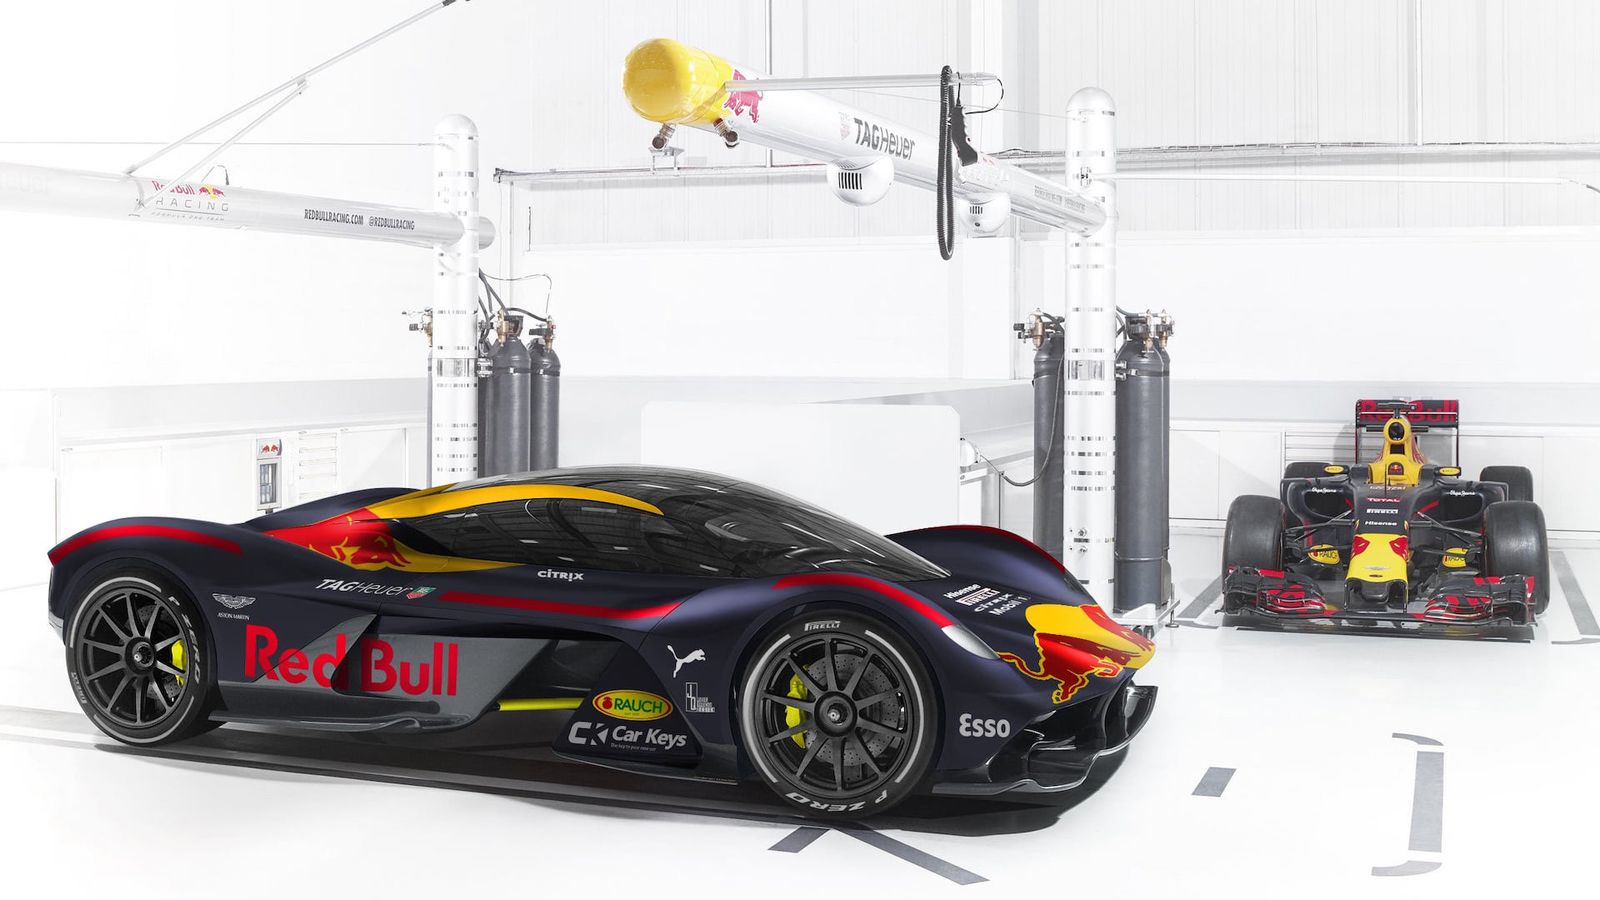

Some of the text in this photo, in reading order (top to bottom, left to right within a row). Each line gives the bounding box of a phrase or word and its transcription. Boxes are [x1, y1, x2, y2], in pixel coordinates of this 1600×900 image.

[304, 209, 415, 230] REDBULLRACING.COM @REDBULLRACING
[804, 620, 841, 631] PIRELLI
[244, 623, 459, 696] Red Bull
[614, 698, 663, 713] RAUCH
[612, 725, 643, 742] Car
[645, 728, 687, 750] Keys
[785, 792, 866, 812] ZERO
